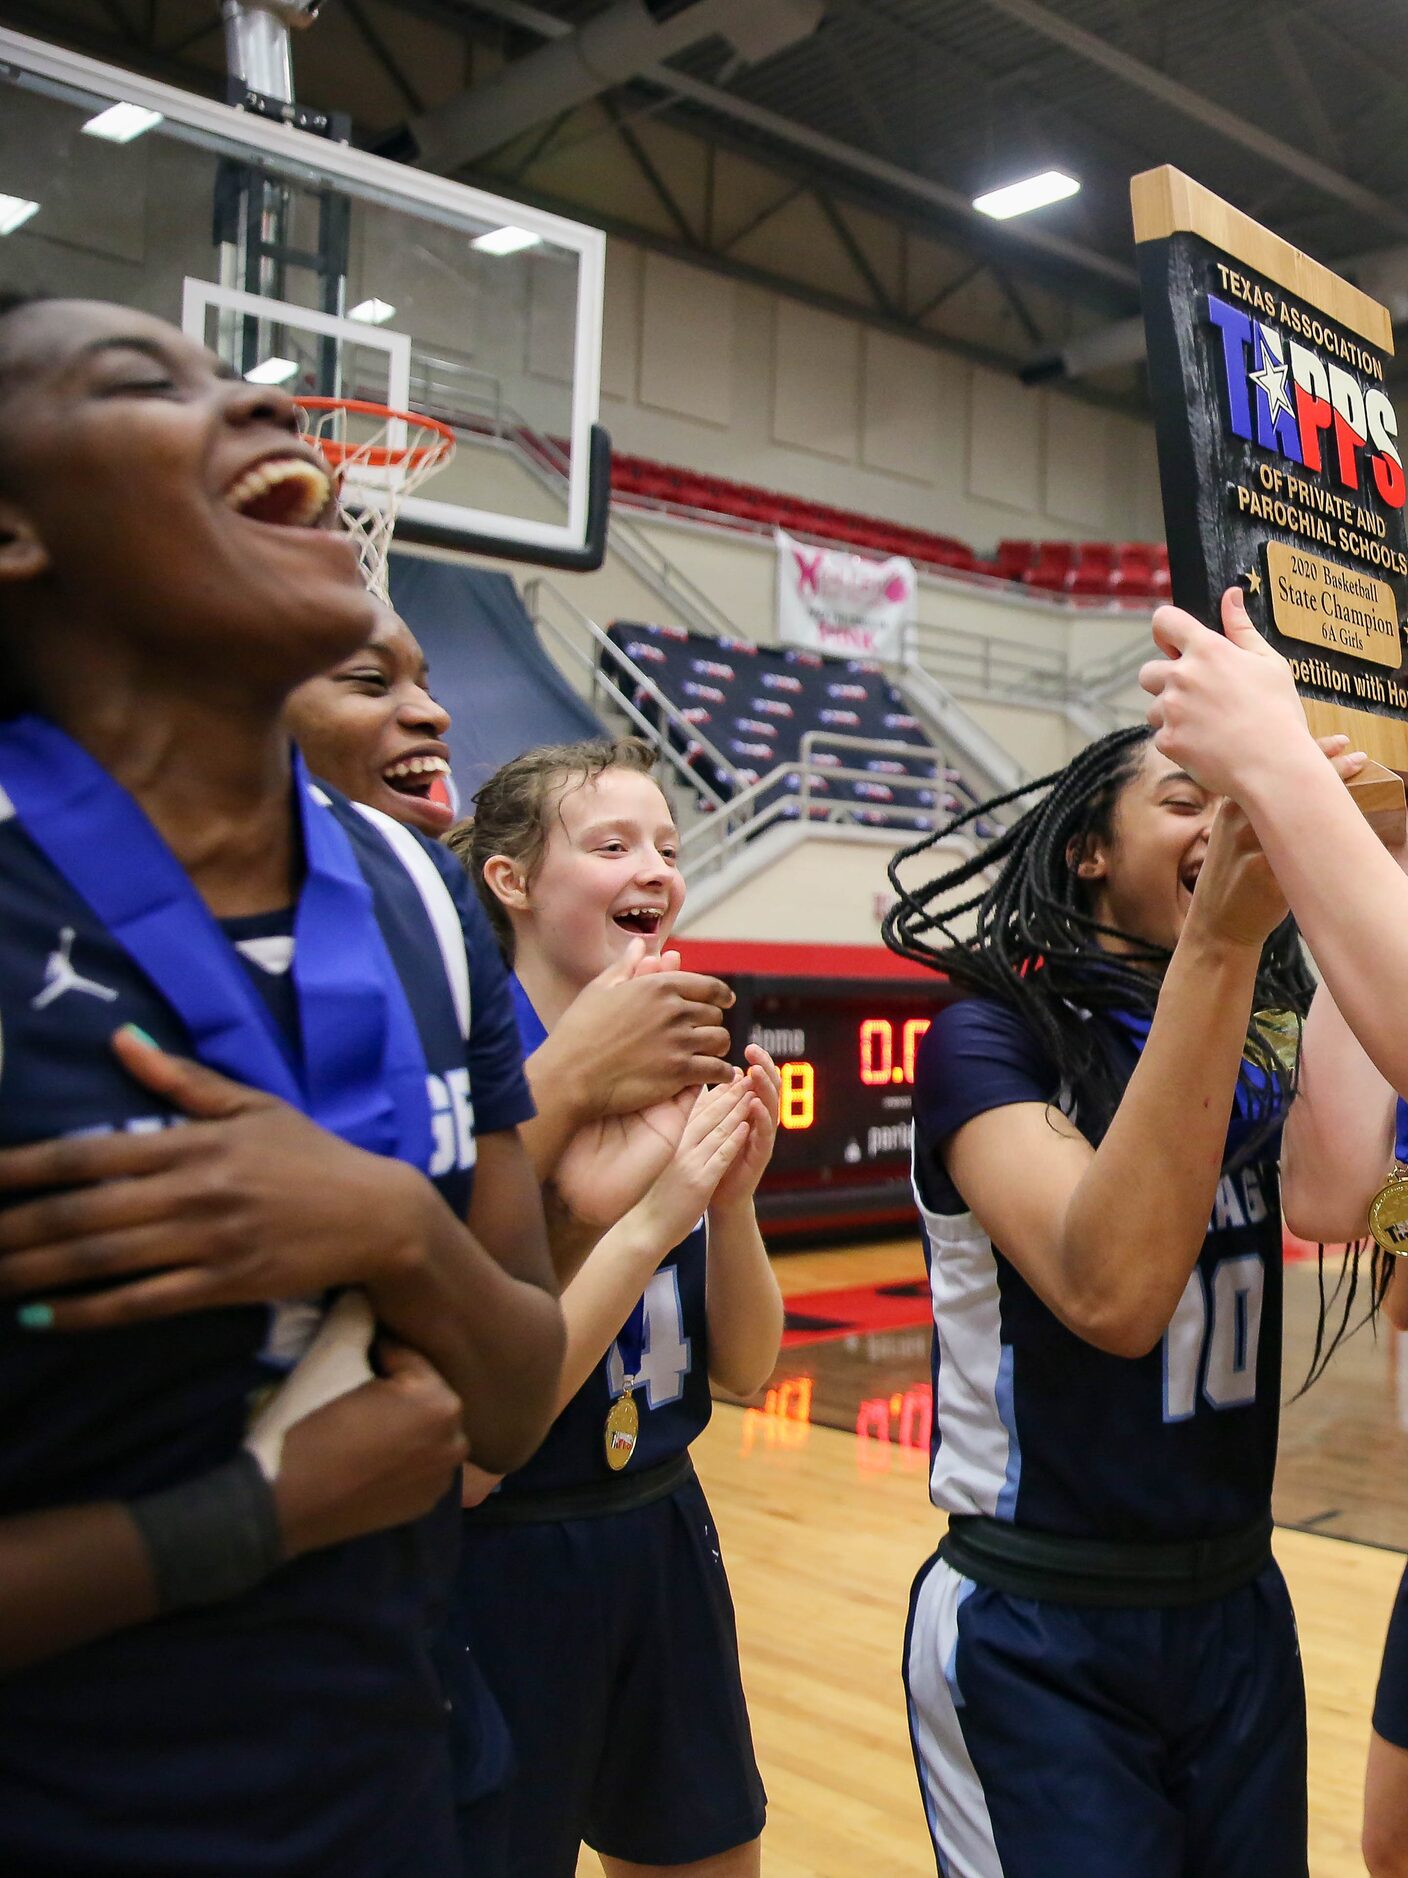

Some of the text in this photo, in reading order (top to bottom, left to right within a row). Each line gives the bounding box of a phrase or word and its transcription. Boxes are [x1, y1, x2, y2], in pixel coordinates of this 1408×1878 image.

[1217, 263, 1383, 381] TEXAS ASSOCIATION
[1208, 294, 1406, 508] TAPPS
[1238, 486, 1407, 575] PAROCHIAL SCHOOLS
[1260, 464, 1386, 538] OF PRIVATE AND
[1279, 576, 1394, 638] State Champion
[1290, 556, 1378, 602] 2020 Basketball
[1321, 622, 1364, 650] 6A Girls
[1354, 672, 1385, 702] with
[1162, 1253, 1265, 1423] 10
